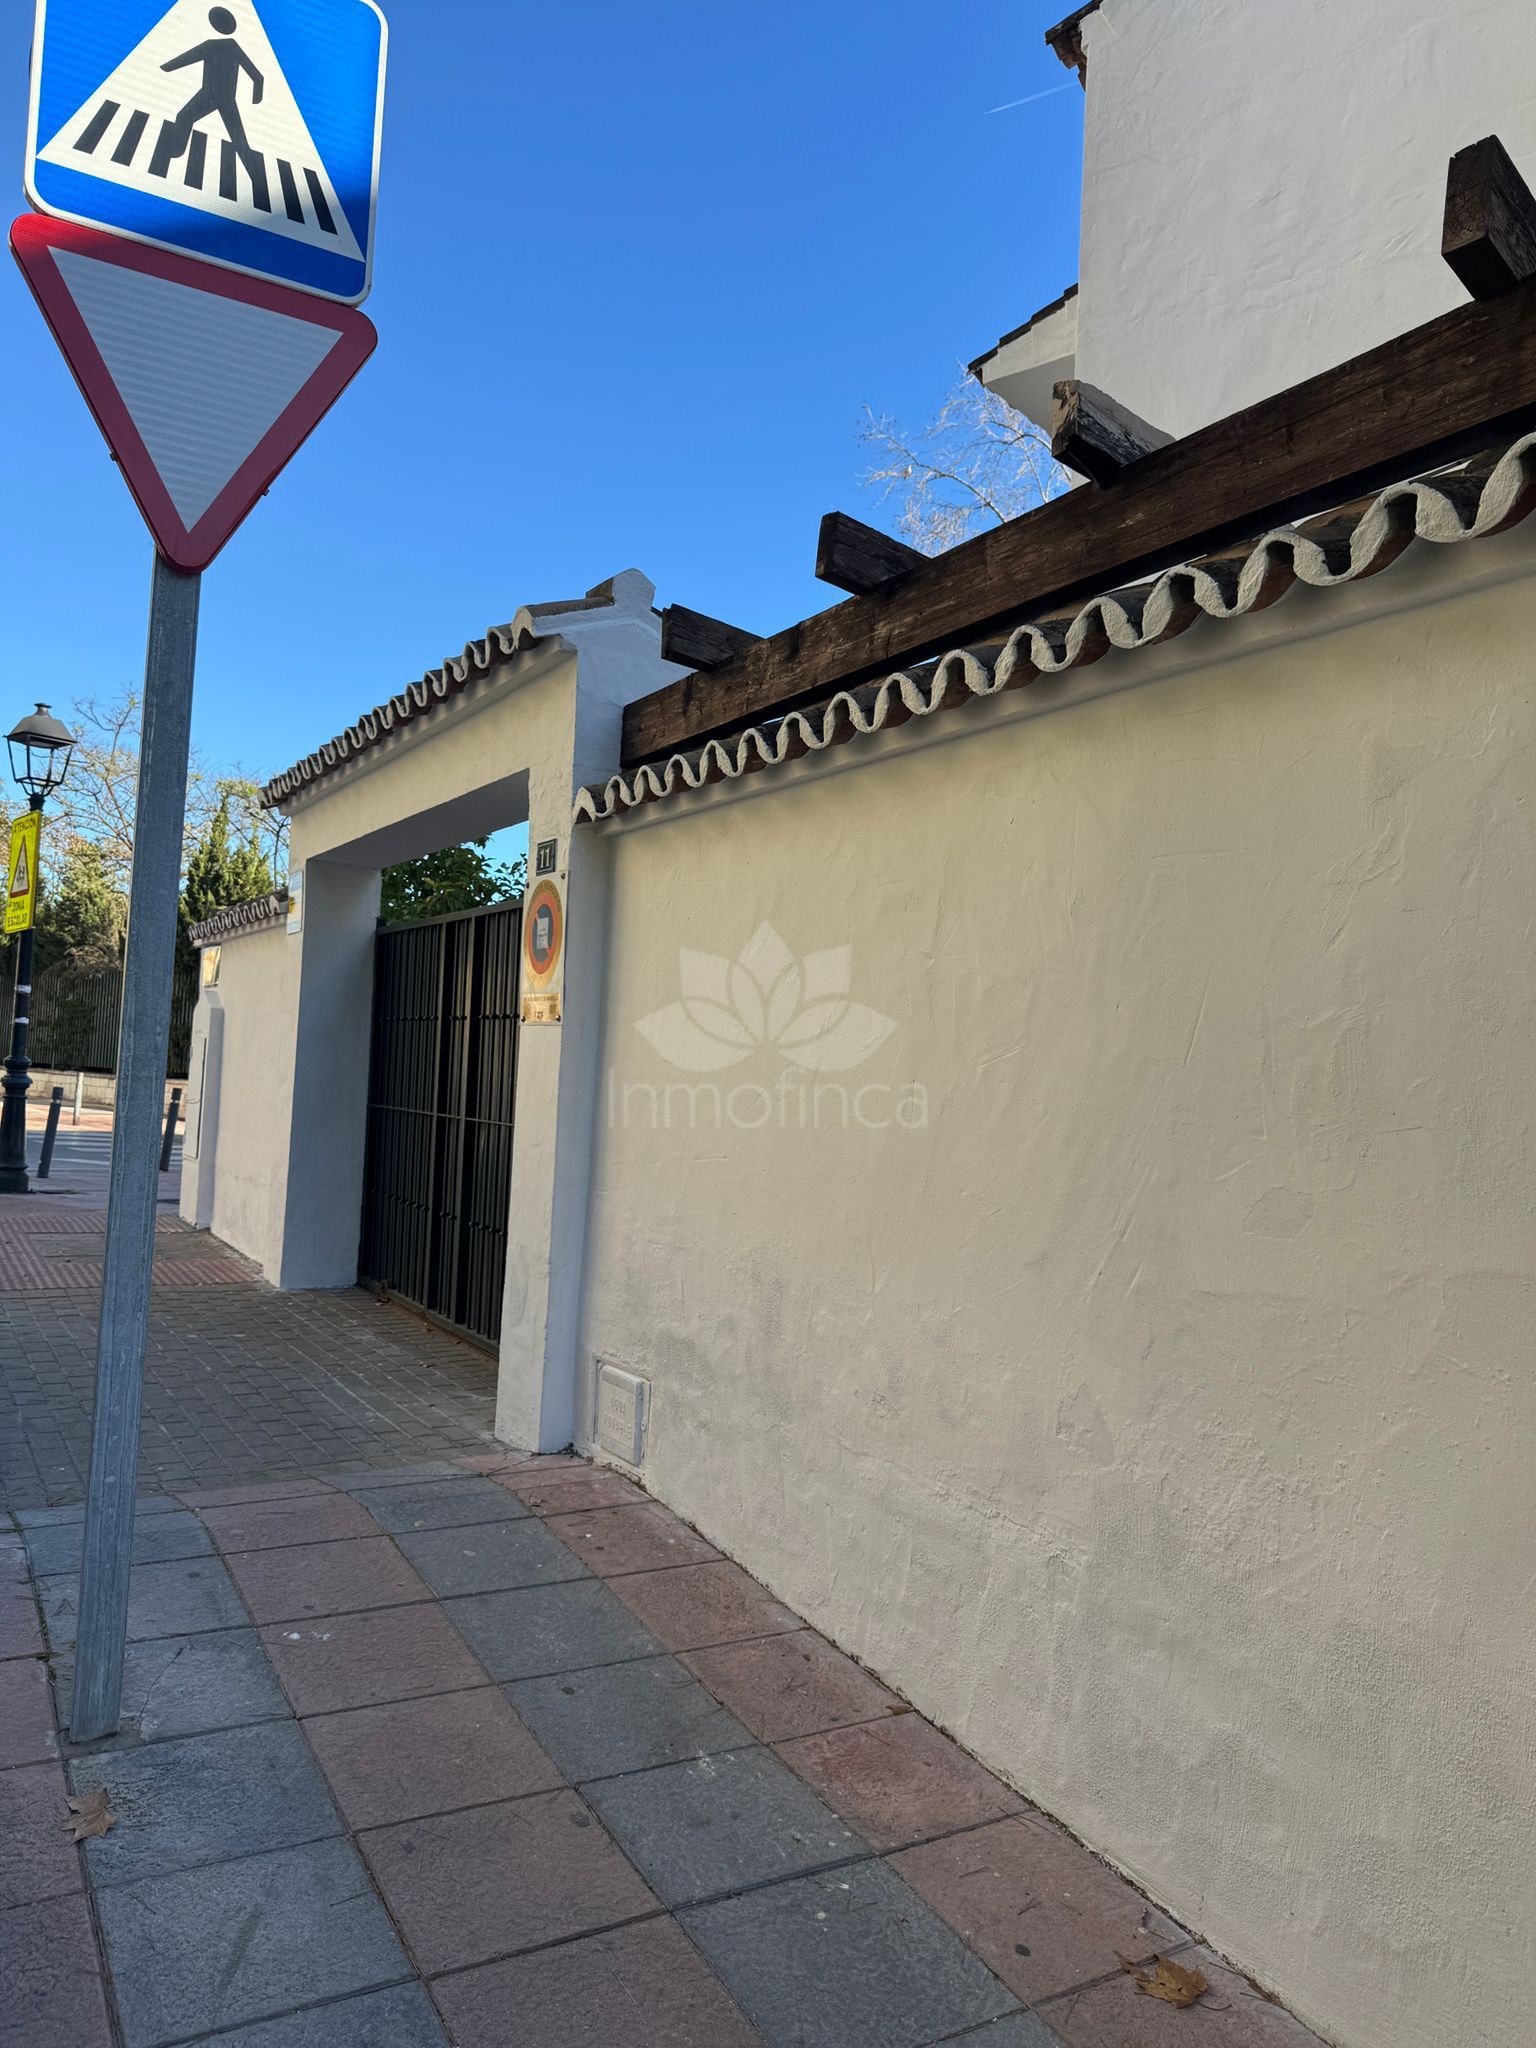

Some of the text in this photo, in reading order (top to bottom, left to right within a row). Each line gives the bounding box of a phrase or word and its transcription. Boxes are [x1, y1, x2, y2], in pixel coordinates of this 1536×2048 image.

[540, 847, 550, 868] 11
[8, 913, 28, 927] ESCOLAR
[610, 1394, 626, 1413] AGUA
[602, 1411, 632, 1440] POTABLE
